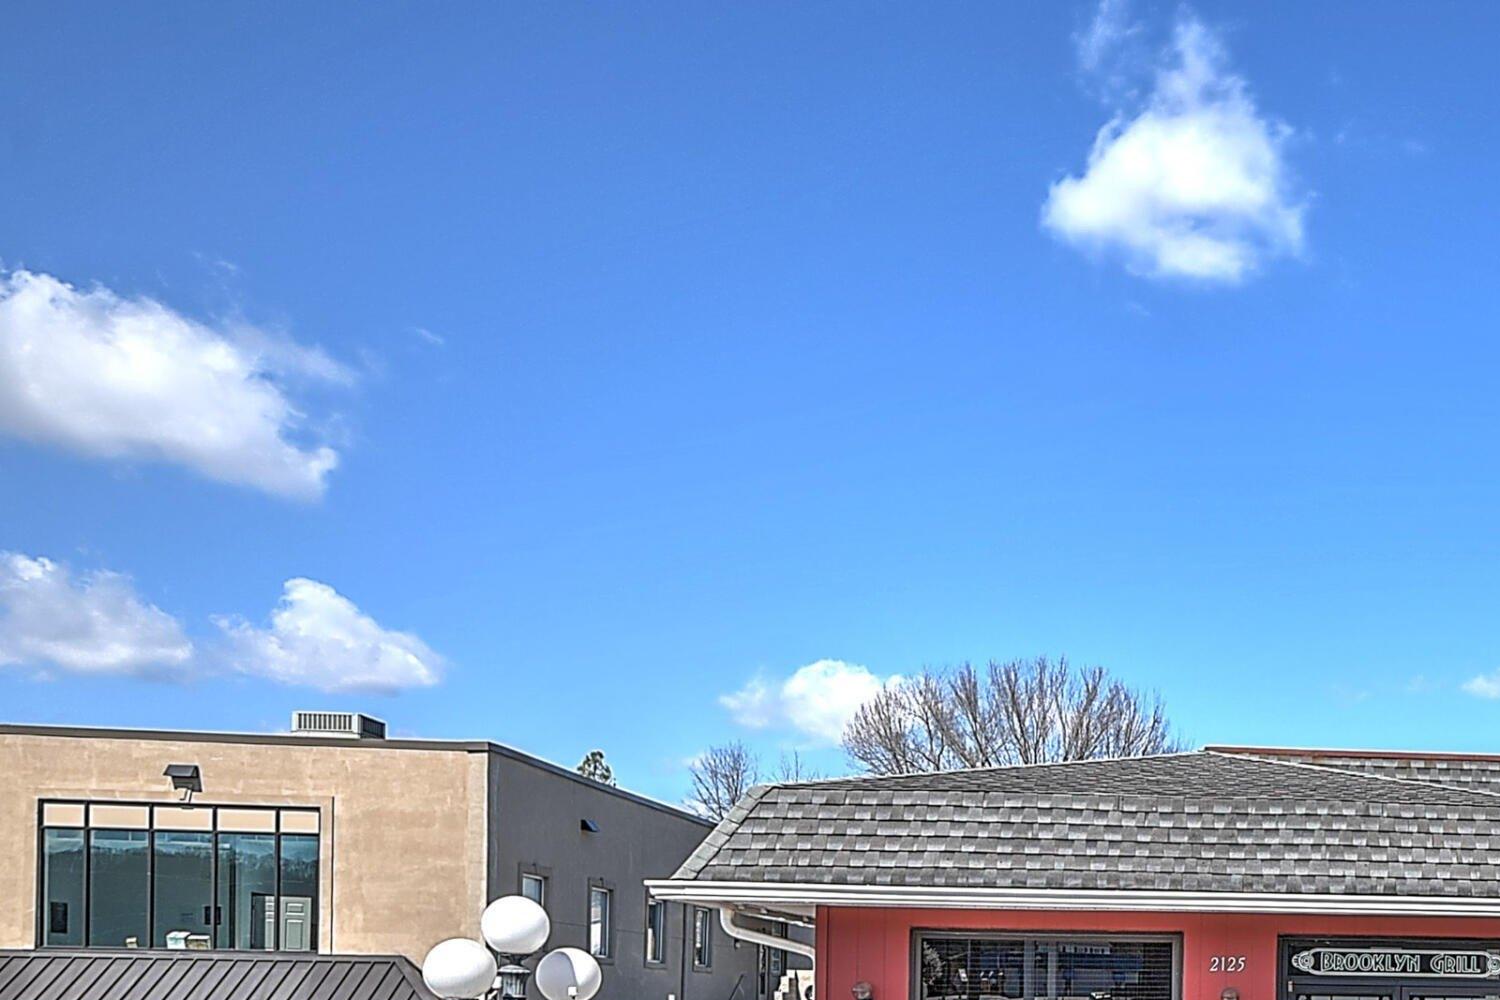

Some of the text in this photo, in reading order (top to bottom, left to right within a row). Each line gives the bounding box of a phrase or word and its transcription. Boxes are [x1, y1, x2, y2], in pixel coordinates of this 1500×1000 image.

[1209, 956, 1246, 971] 2125
[1320, 951, 1481, 974] BROOKLYN GRILL
